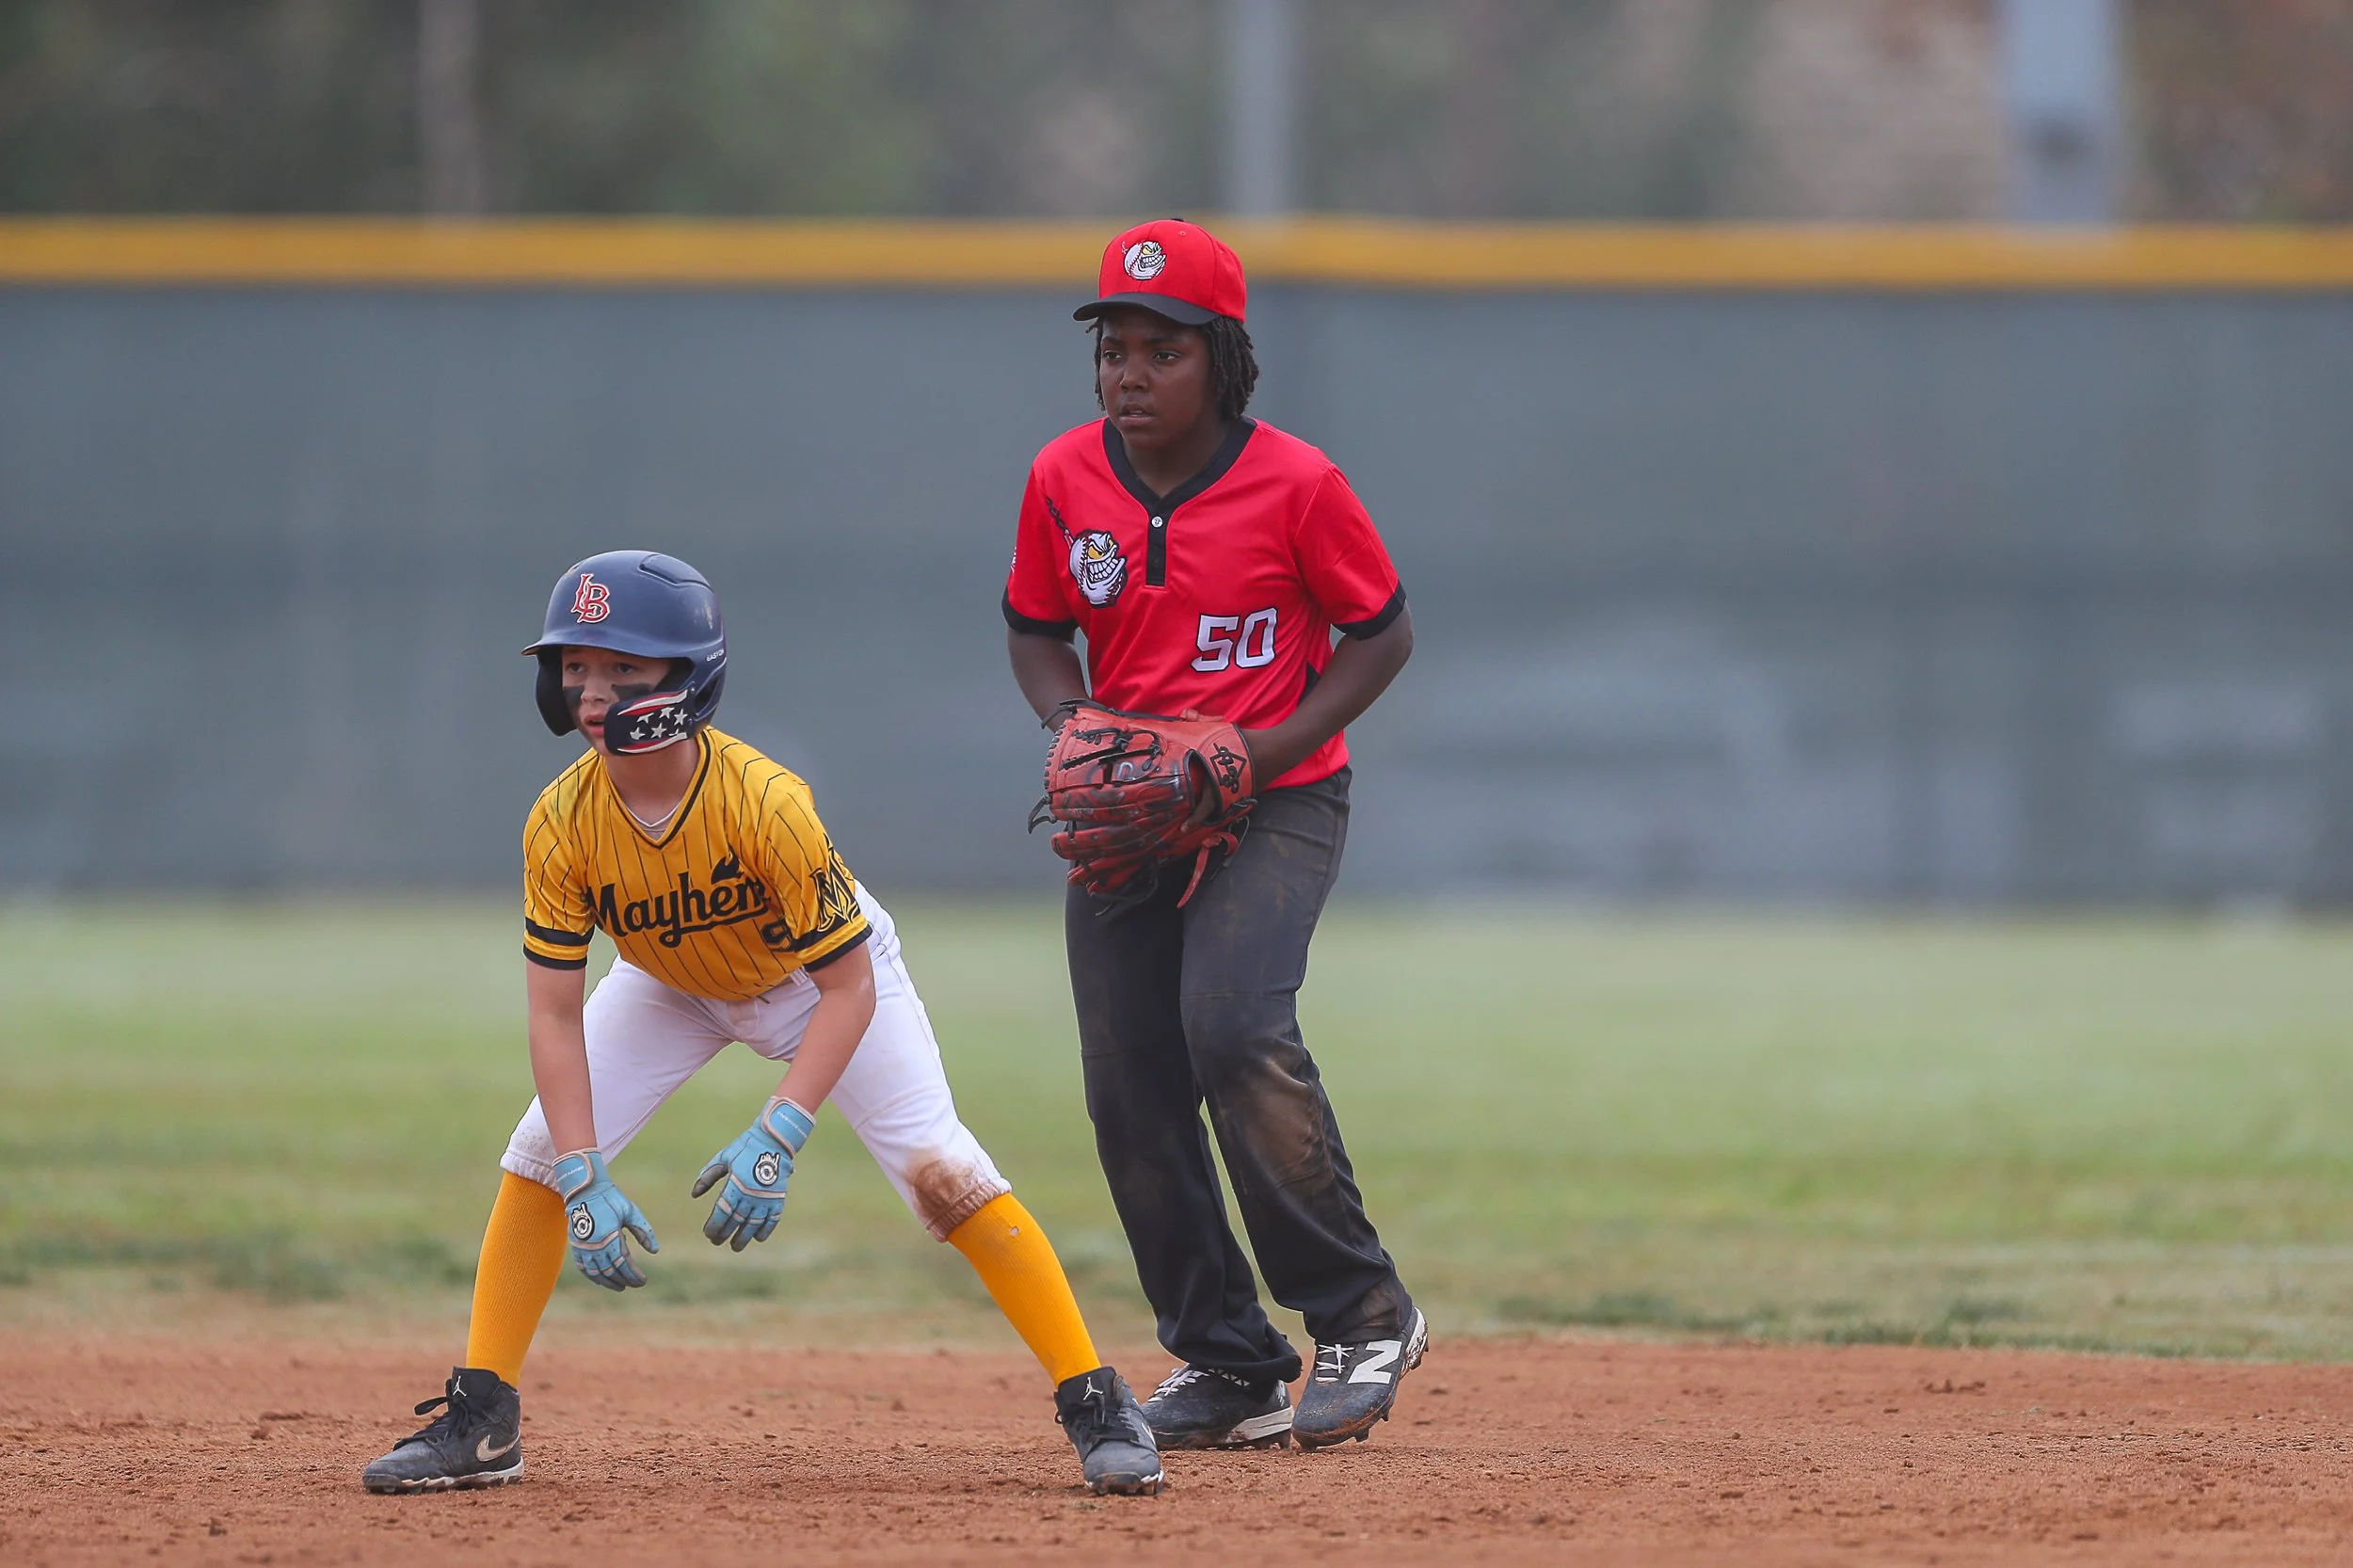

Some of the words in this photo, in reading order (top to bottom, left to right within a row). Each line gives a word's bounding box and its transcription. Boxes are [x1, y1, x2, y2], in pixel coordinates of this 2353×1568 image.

[570, 573, 610, 623] LB
[1192, 607, 1277, 672] 50
[1347, 1339, 1402, 1384] N
